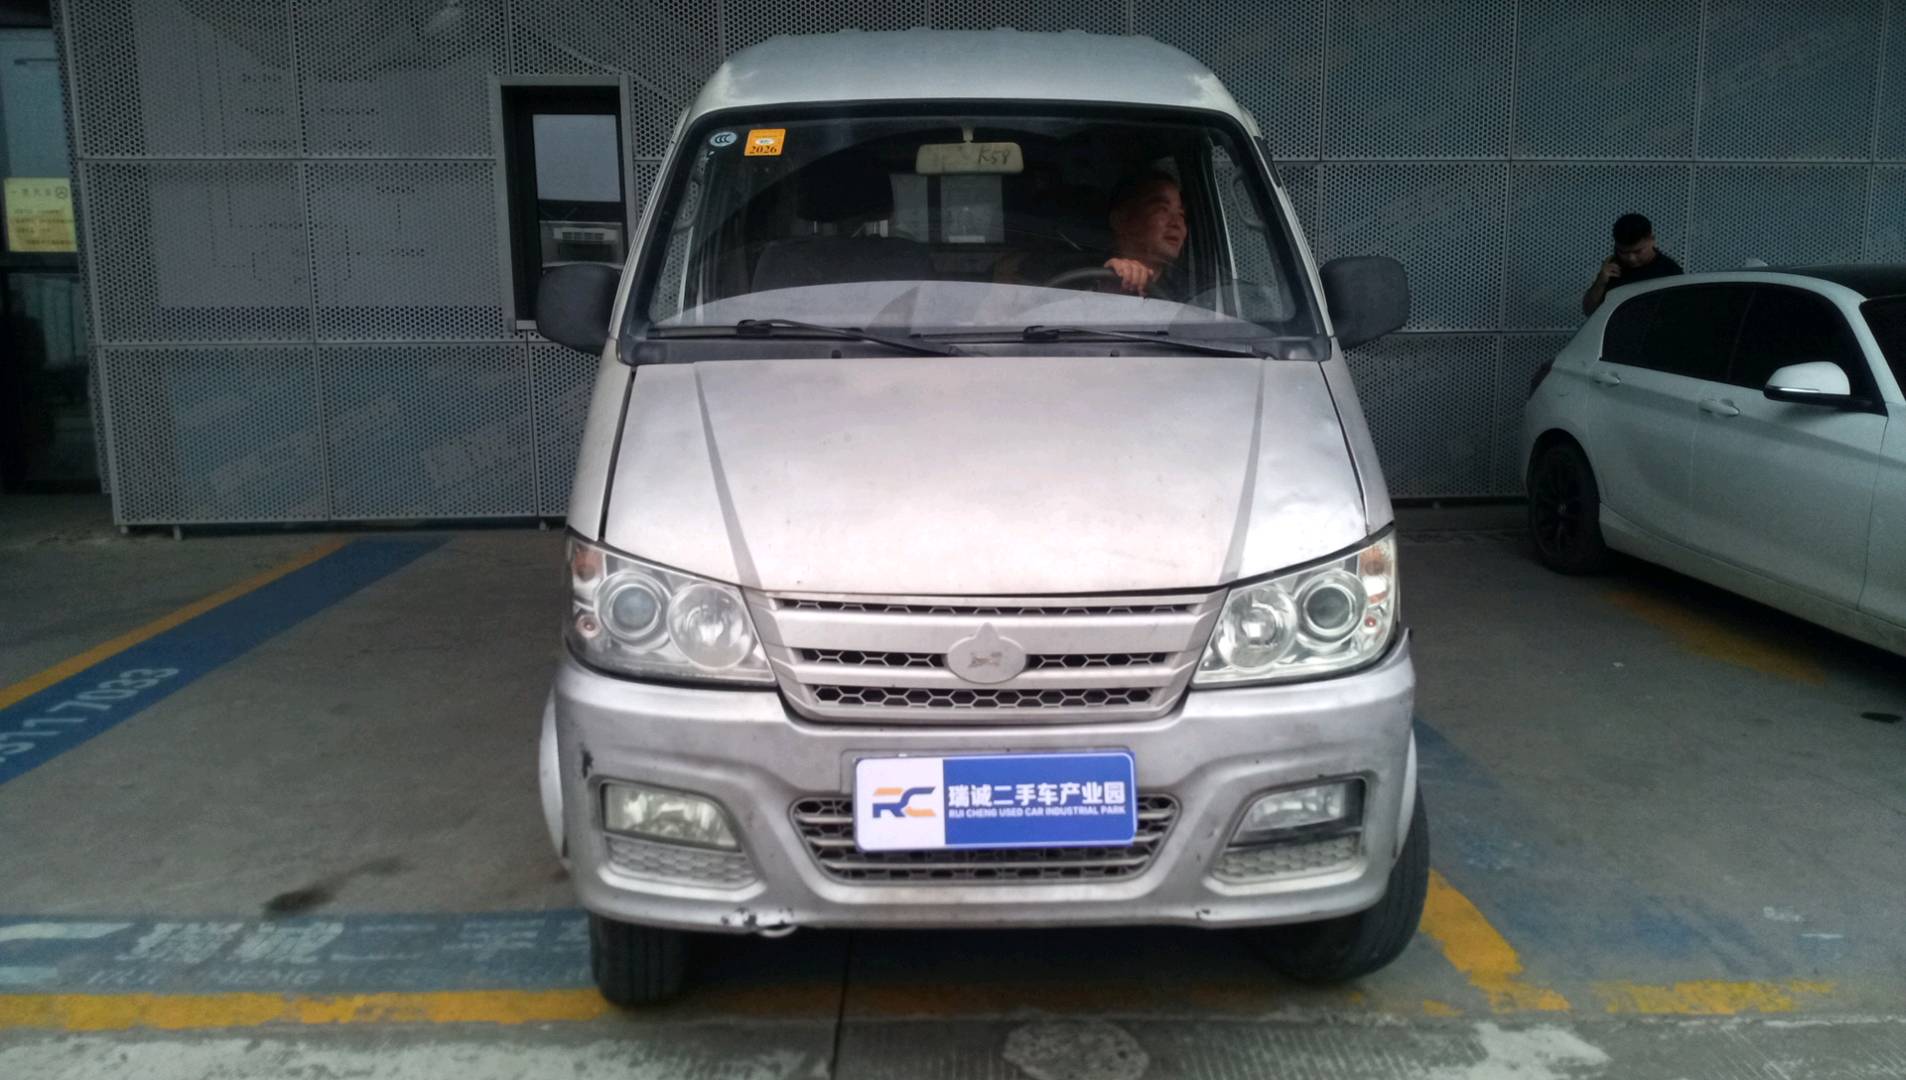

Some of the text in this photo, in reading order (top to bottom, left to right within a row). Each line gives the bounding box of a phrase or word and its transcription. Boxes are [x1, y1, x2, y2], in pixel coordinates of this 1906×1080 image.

[749, 145, 777, 154] 2026
[872, 786, 936, 819] RC
[948, 781, 1126, 808] 瑞诚二手车产业园
[948, 804, 1126, 819] RUI CHENG USED CAR INDUSTRIAL PARK
